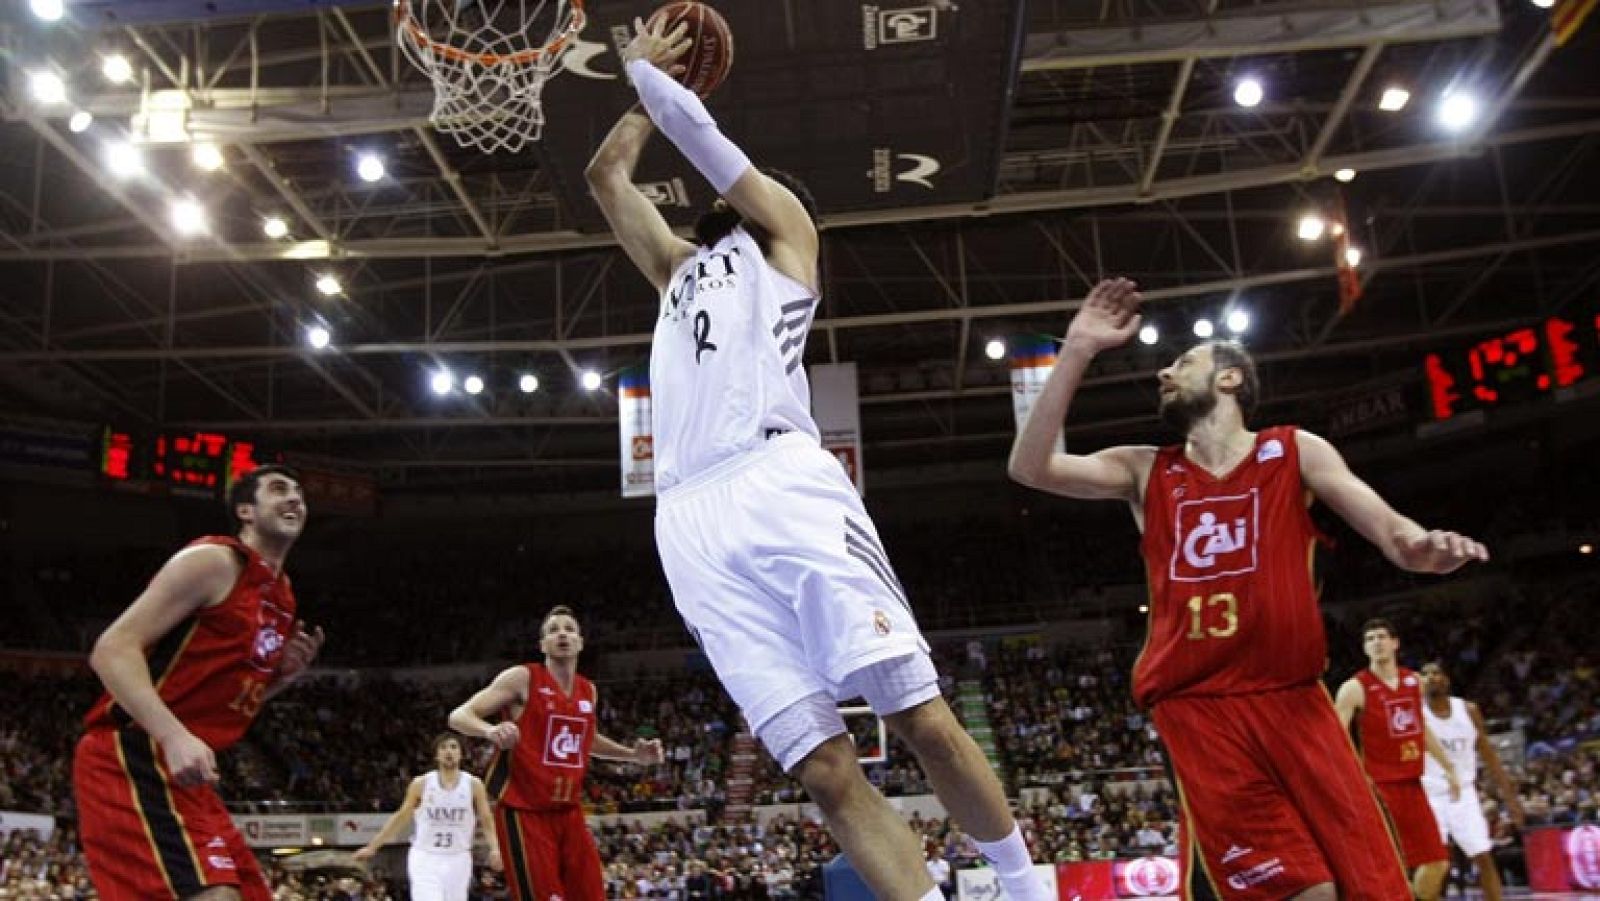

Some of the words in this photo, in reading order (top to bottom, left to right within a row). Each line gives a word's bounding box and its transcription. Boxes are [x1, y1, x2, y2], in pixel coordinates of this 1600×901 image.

[1187, 592, 1238, 640] 13
[425, 806, 469, 821] MMT
[433, 831, 453, 849] 23
